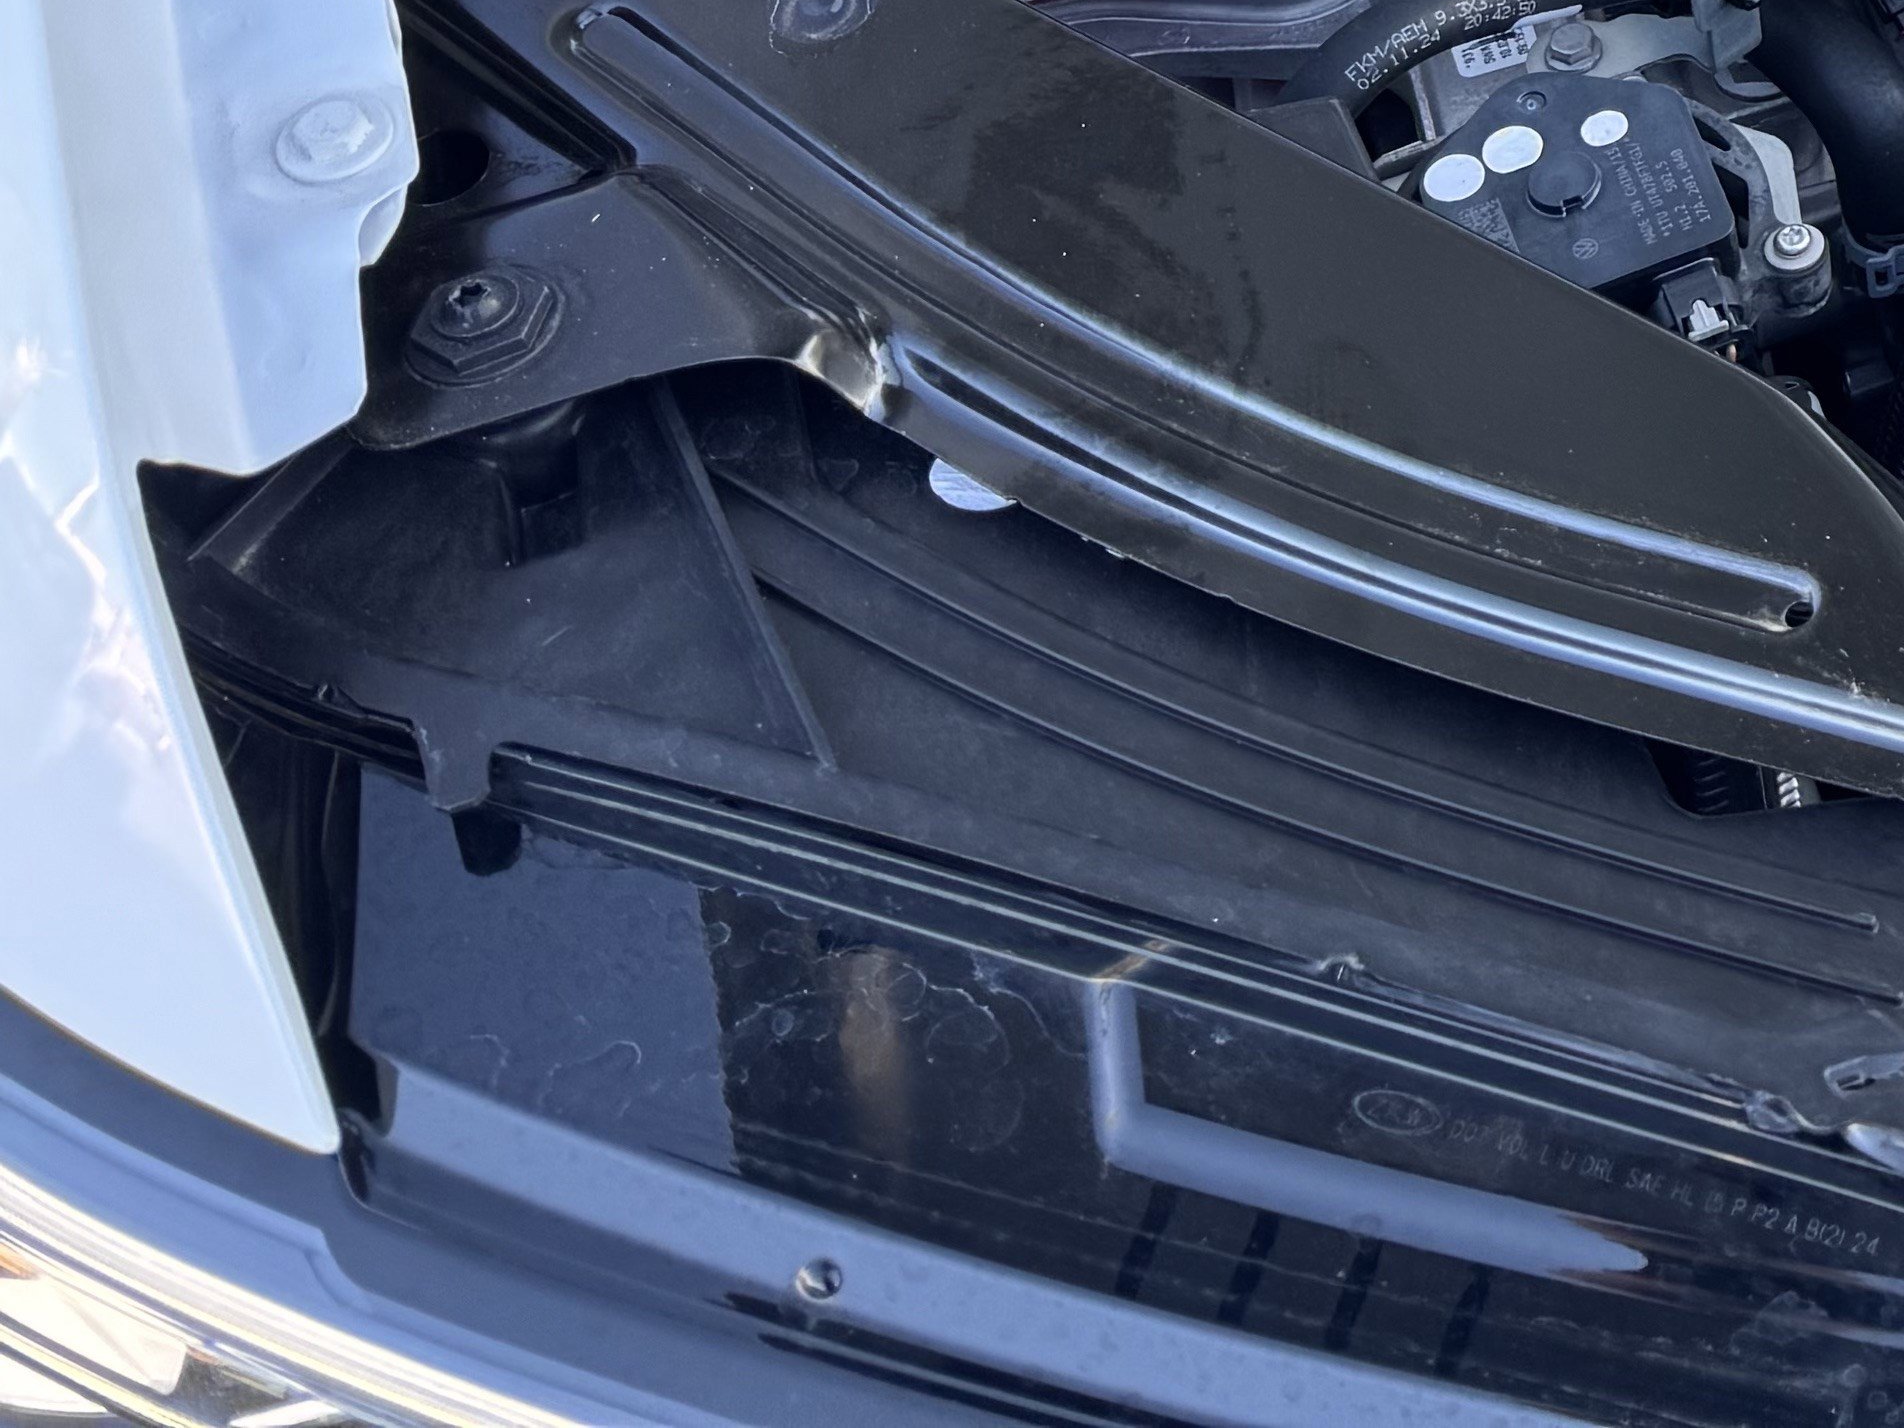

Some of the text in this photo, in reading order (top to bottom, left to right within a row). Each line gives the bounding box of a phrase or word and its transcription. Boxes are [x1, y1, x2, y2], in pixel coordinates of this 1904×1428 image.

[1344, 19, 1428, 82] FKM/AEM
[1356, 29, 1440, 91] 02.11.24
[1464, 0, 1537, 31] 20:42:50
